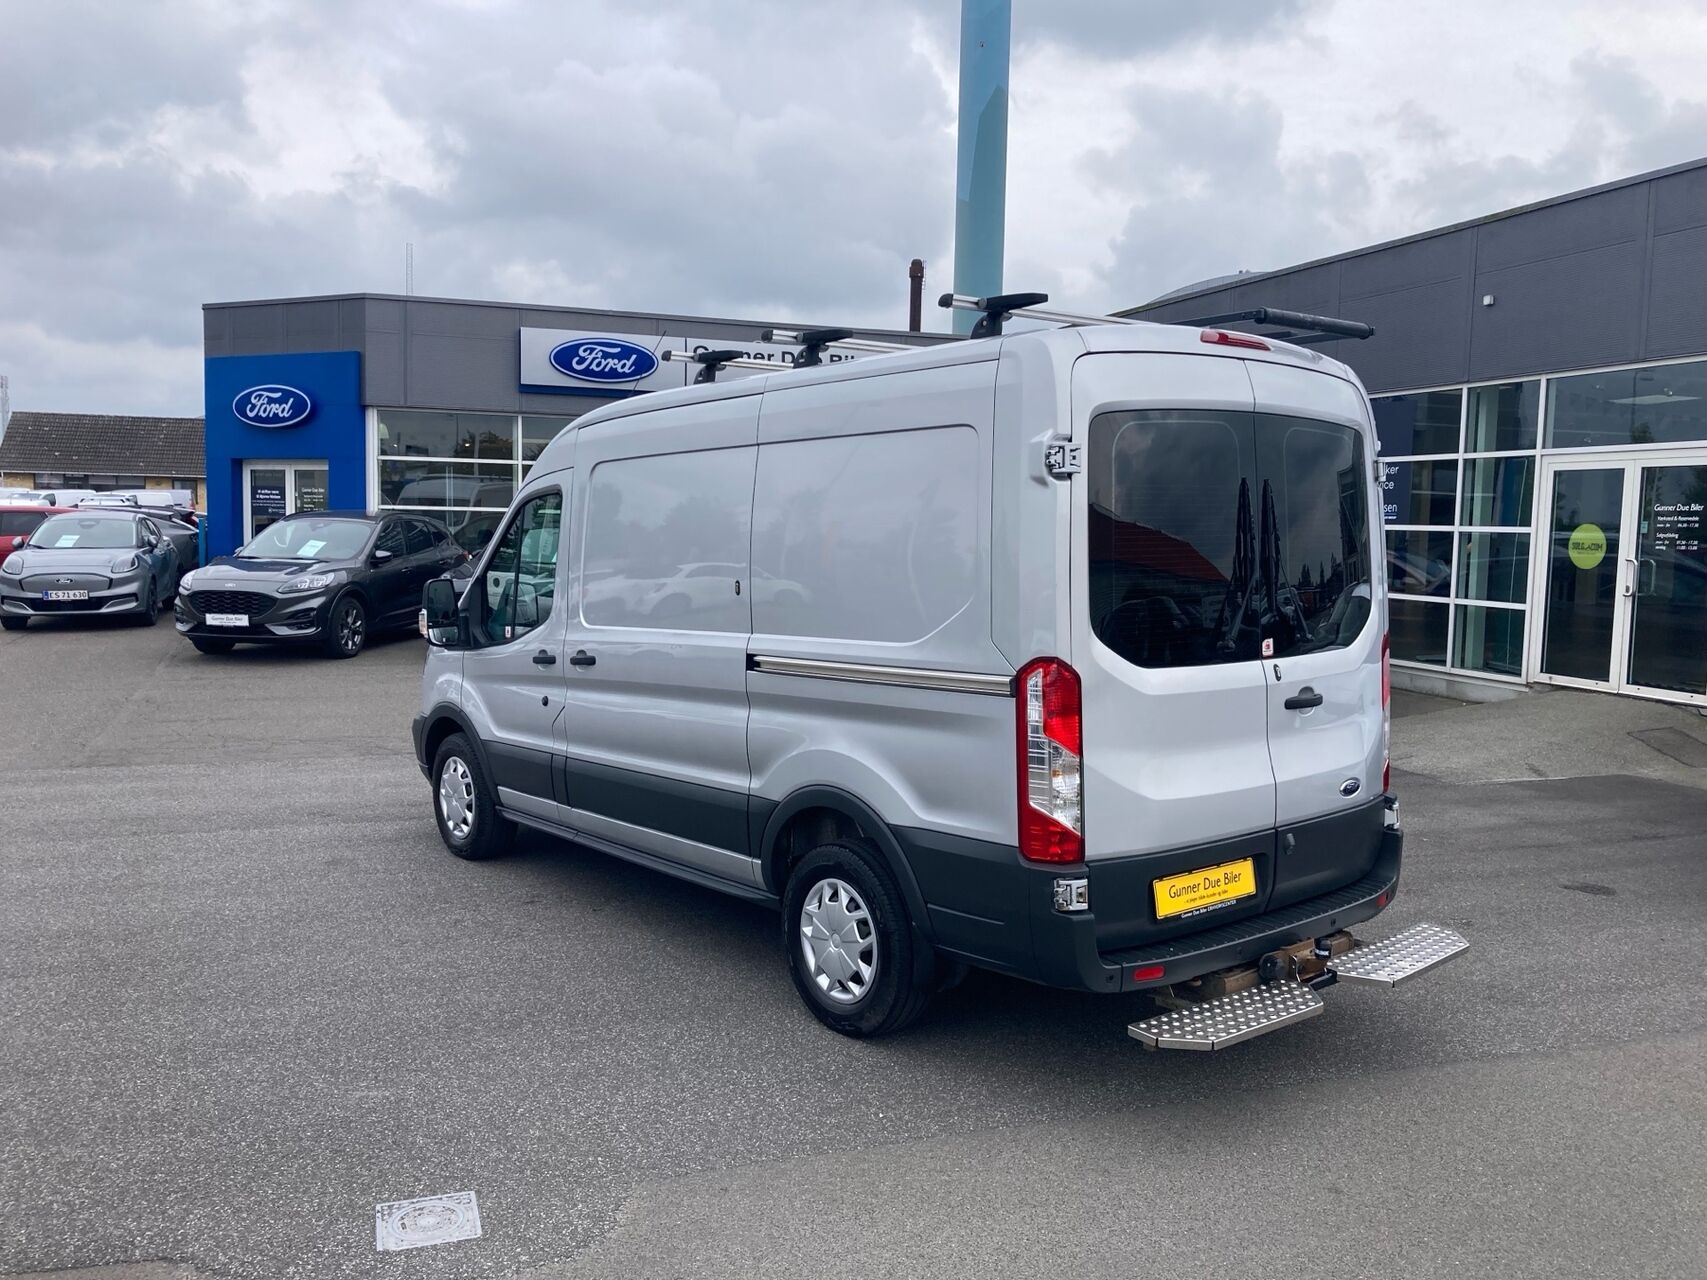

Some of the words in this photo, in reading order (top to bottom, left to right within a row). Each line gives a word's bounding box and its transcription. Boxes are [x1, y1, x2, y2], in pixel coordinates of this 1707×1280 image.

[572, 344, 637, 373] Ford
[246, 391, 294, 418] Ford
[1676, 503, 1690, 511] Due
[1169, 882, 1201, 899] Gunner
[1203, 877, 1221, 890] Due
[1223, 871, 1242, 886] Biler
